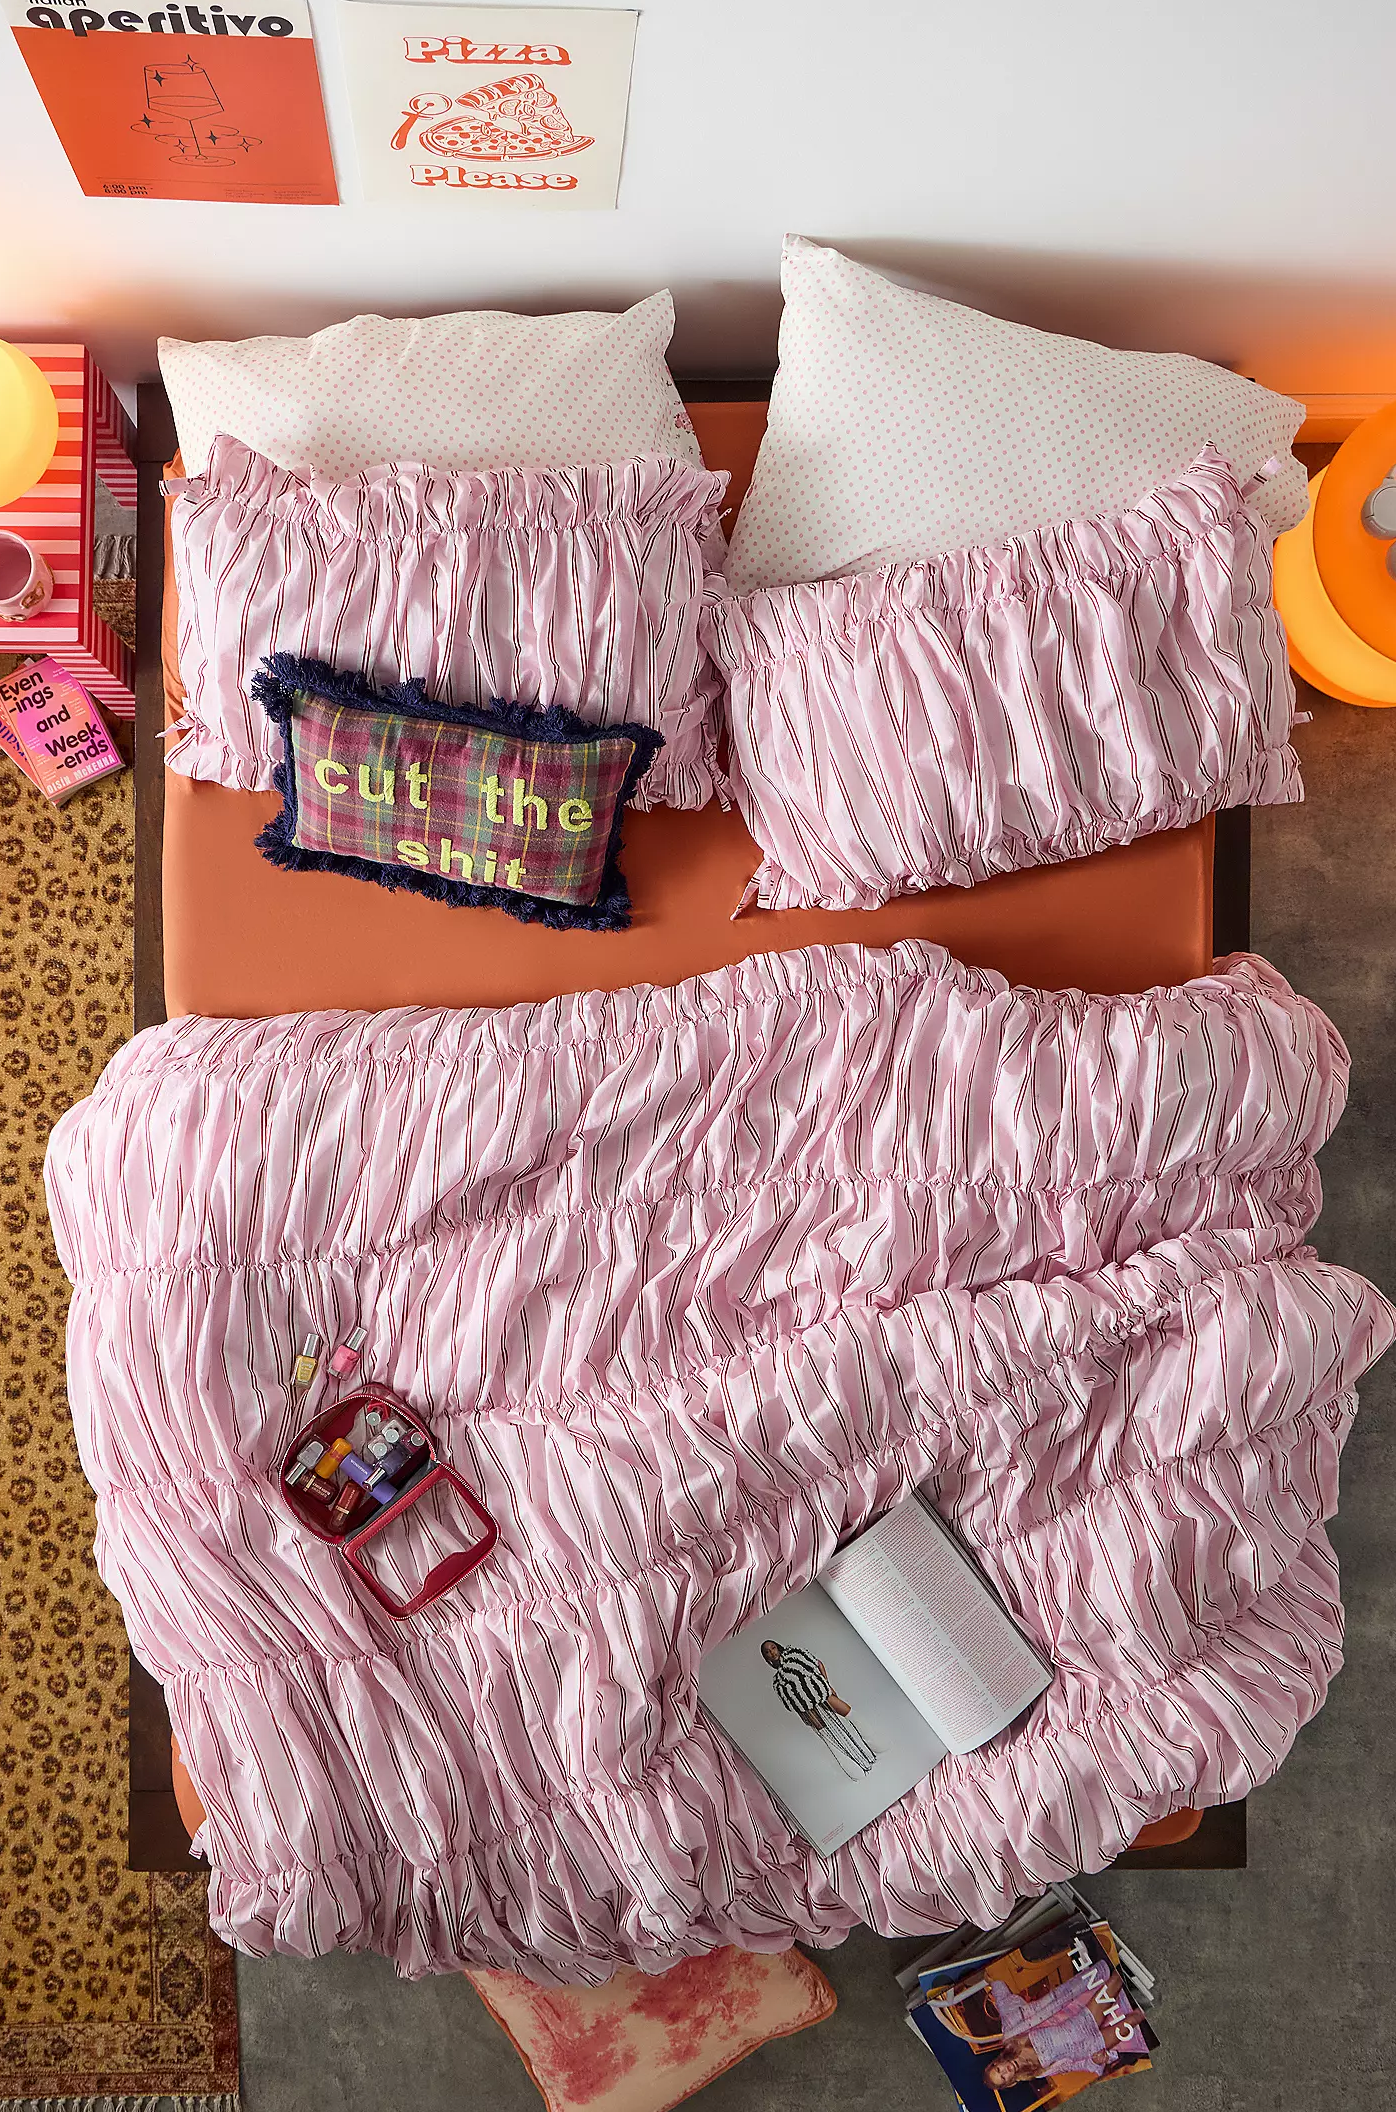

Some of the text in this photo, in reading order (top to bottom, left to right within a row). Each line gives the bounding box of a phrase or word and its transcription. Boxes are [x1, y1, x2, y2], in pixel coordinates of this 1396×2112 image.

[26, 4, 294, 37] aperitivo
[403, 35, 573, 66] Pizza
[409, 164, 579, 191] Please
[0, 671, 44, 702] Even
[9, 685, 54, 714] -ings
[36, 704, 71, 733] and
[44, 721, 102, 758] Week
[56, 738, 109, 770] -ends
[313, 757, 593, 833] cut the
[396, 837, 528, 890] shit
[1067, 1936, 1134, 2042] CHANEL
